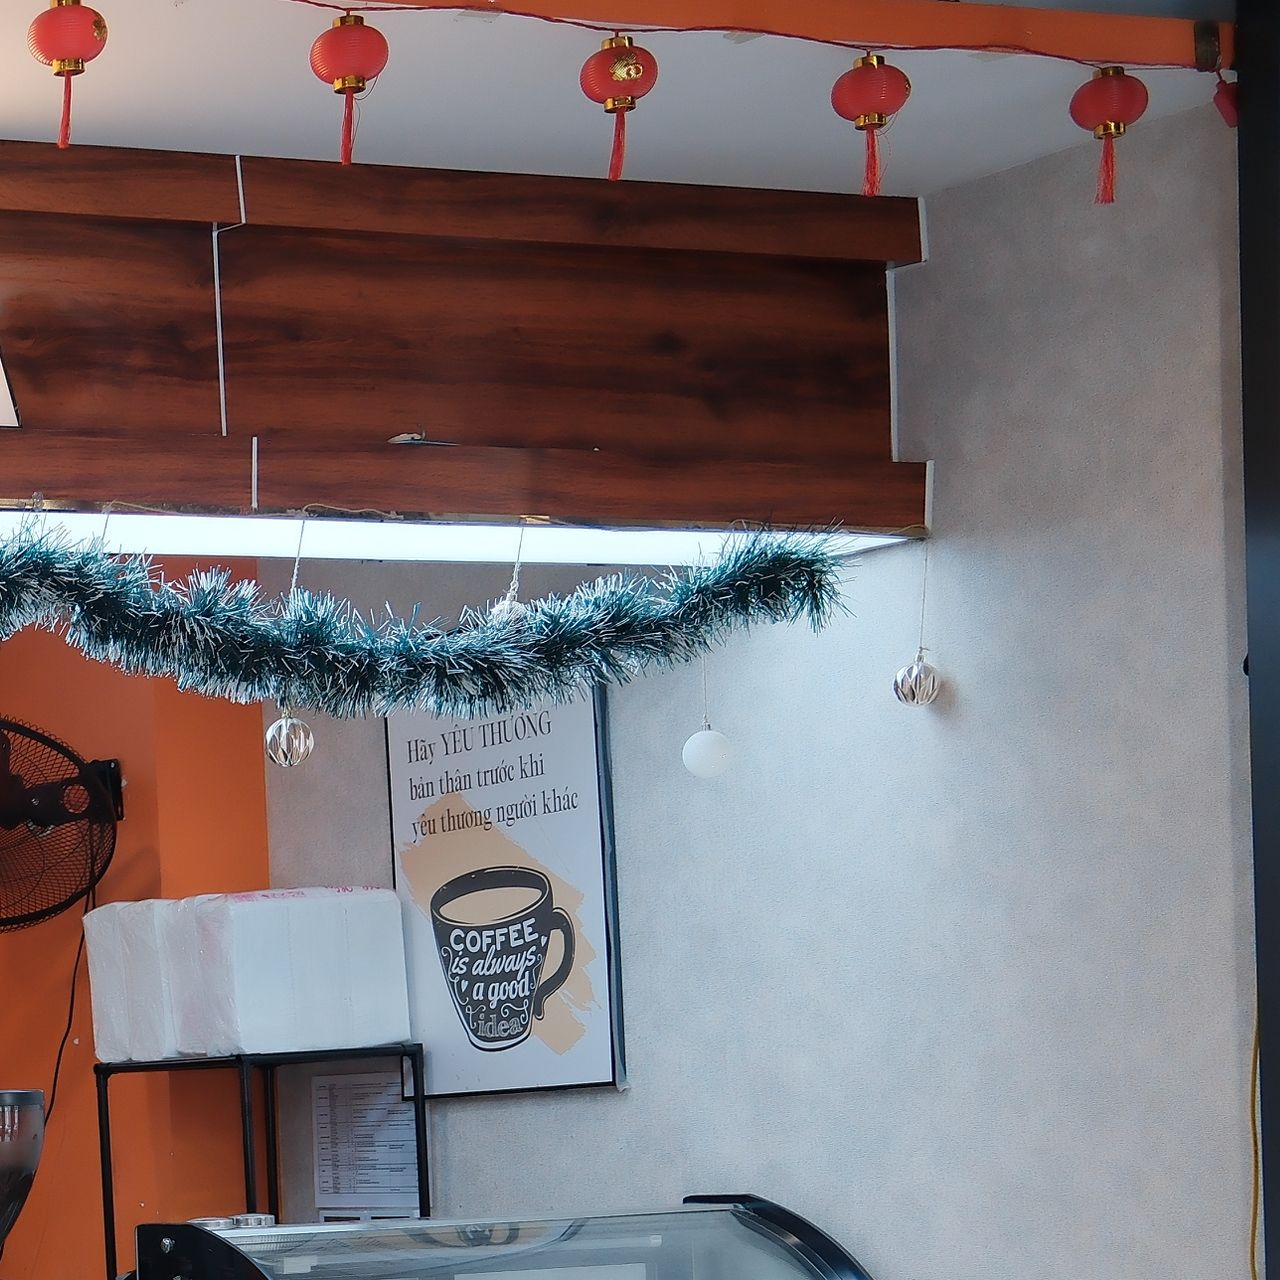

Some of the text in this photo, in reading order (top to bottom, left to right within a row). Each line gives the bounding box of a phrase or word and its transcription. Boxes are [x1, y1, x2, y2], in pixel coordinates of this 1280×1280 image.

[407, 710, 552, 765] Hãy YÊU THƯƠNG
[409, 753, 545, 801] bản thân trước khi
[412, 786, 579, 843] yêu thương người khác
[450, 917, 539, 953] COFFEE
[452, 945, 537, 981] is always
[472, 970, 530, 1009] a good
[477, 1013, 523, 1038] idea
